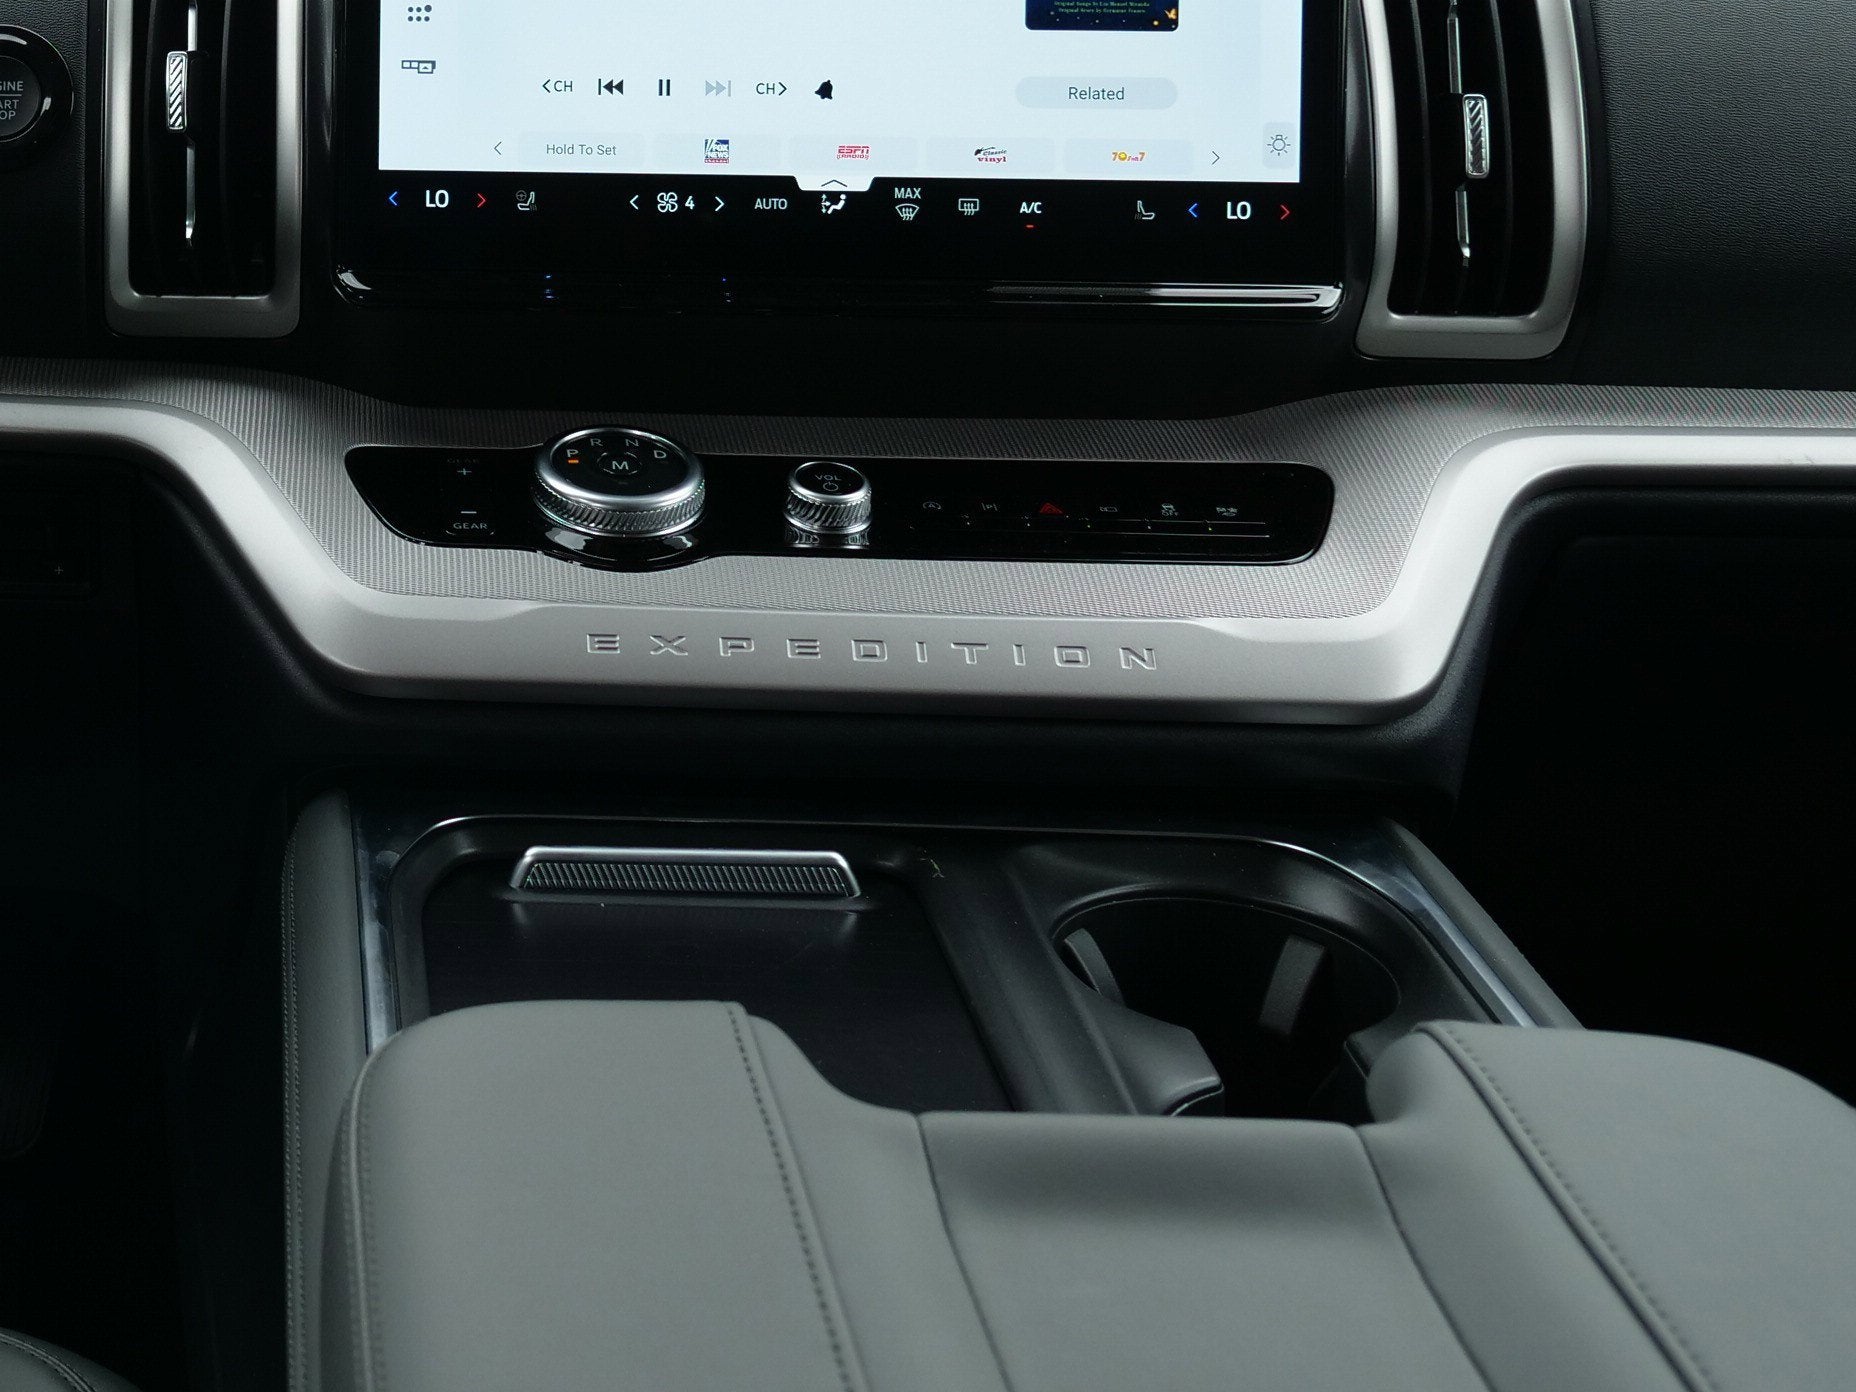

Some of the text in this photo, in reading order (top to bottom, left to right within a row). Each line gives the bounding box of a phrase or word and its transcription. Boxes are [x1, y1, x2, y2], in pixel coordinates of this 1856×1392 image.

[1067, 85, 1125, 101] Related
[546, 144, 617, 156] Hold To Set
[838, 145, 870, 154] ESPN
[425, 189, 449, 209] LO
[895, 187, 922, 199] MAX
[684, 195, 695, 210] 4
[754, 198, 788, 210] AUTO
[1019, 202, 1042, 214] A/C
[1226, 201, 1252, 220] LO
[590, 438, 604, 447] R
[625, 438, 640, 447] N
[566, 449, 579, 458] P
[653, 450, 667, 459] D
[611, 460, 630, 470] M
[453, 522, 488, 530] GEAR
[585, 632, 1158, 670] EXPEDITION
